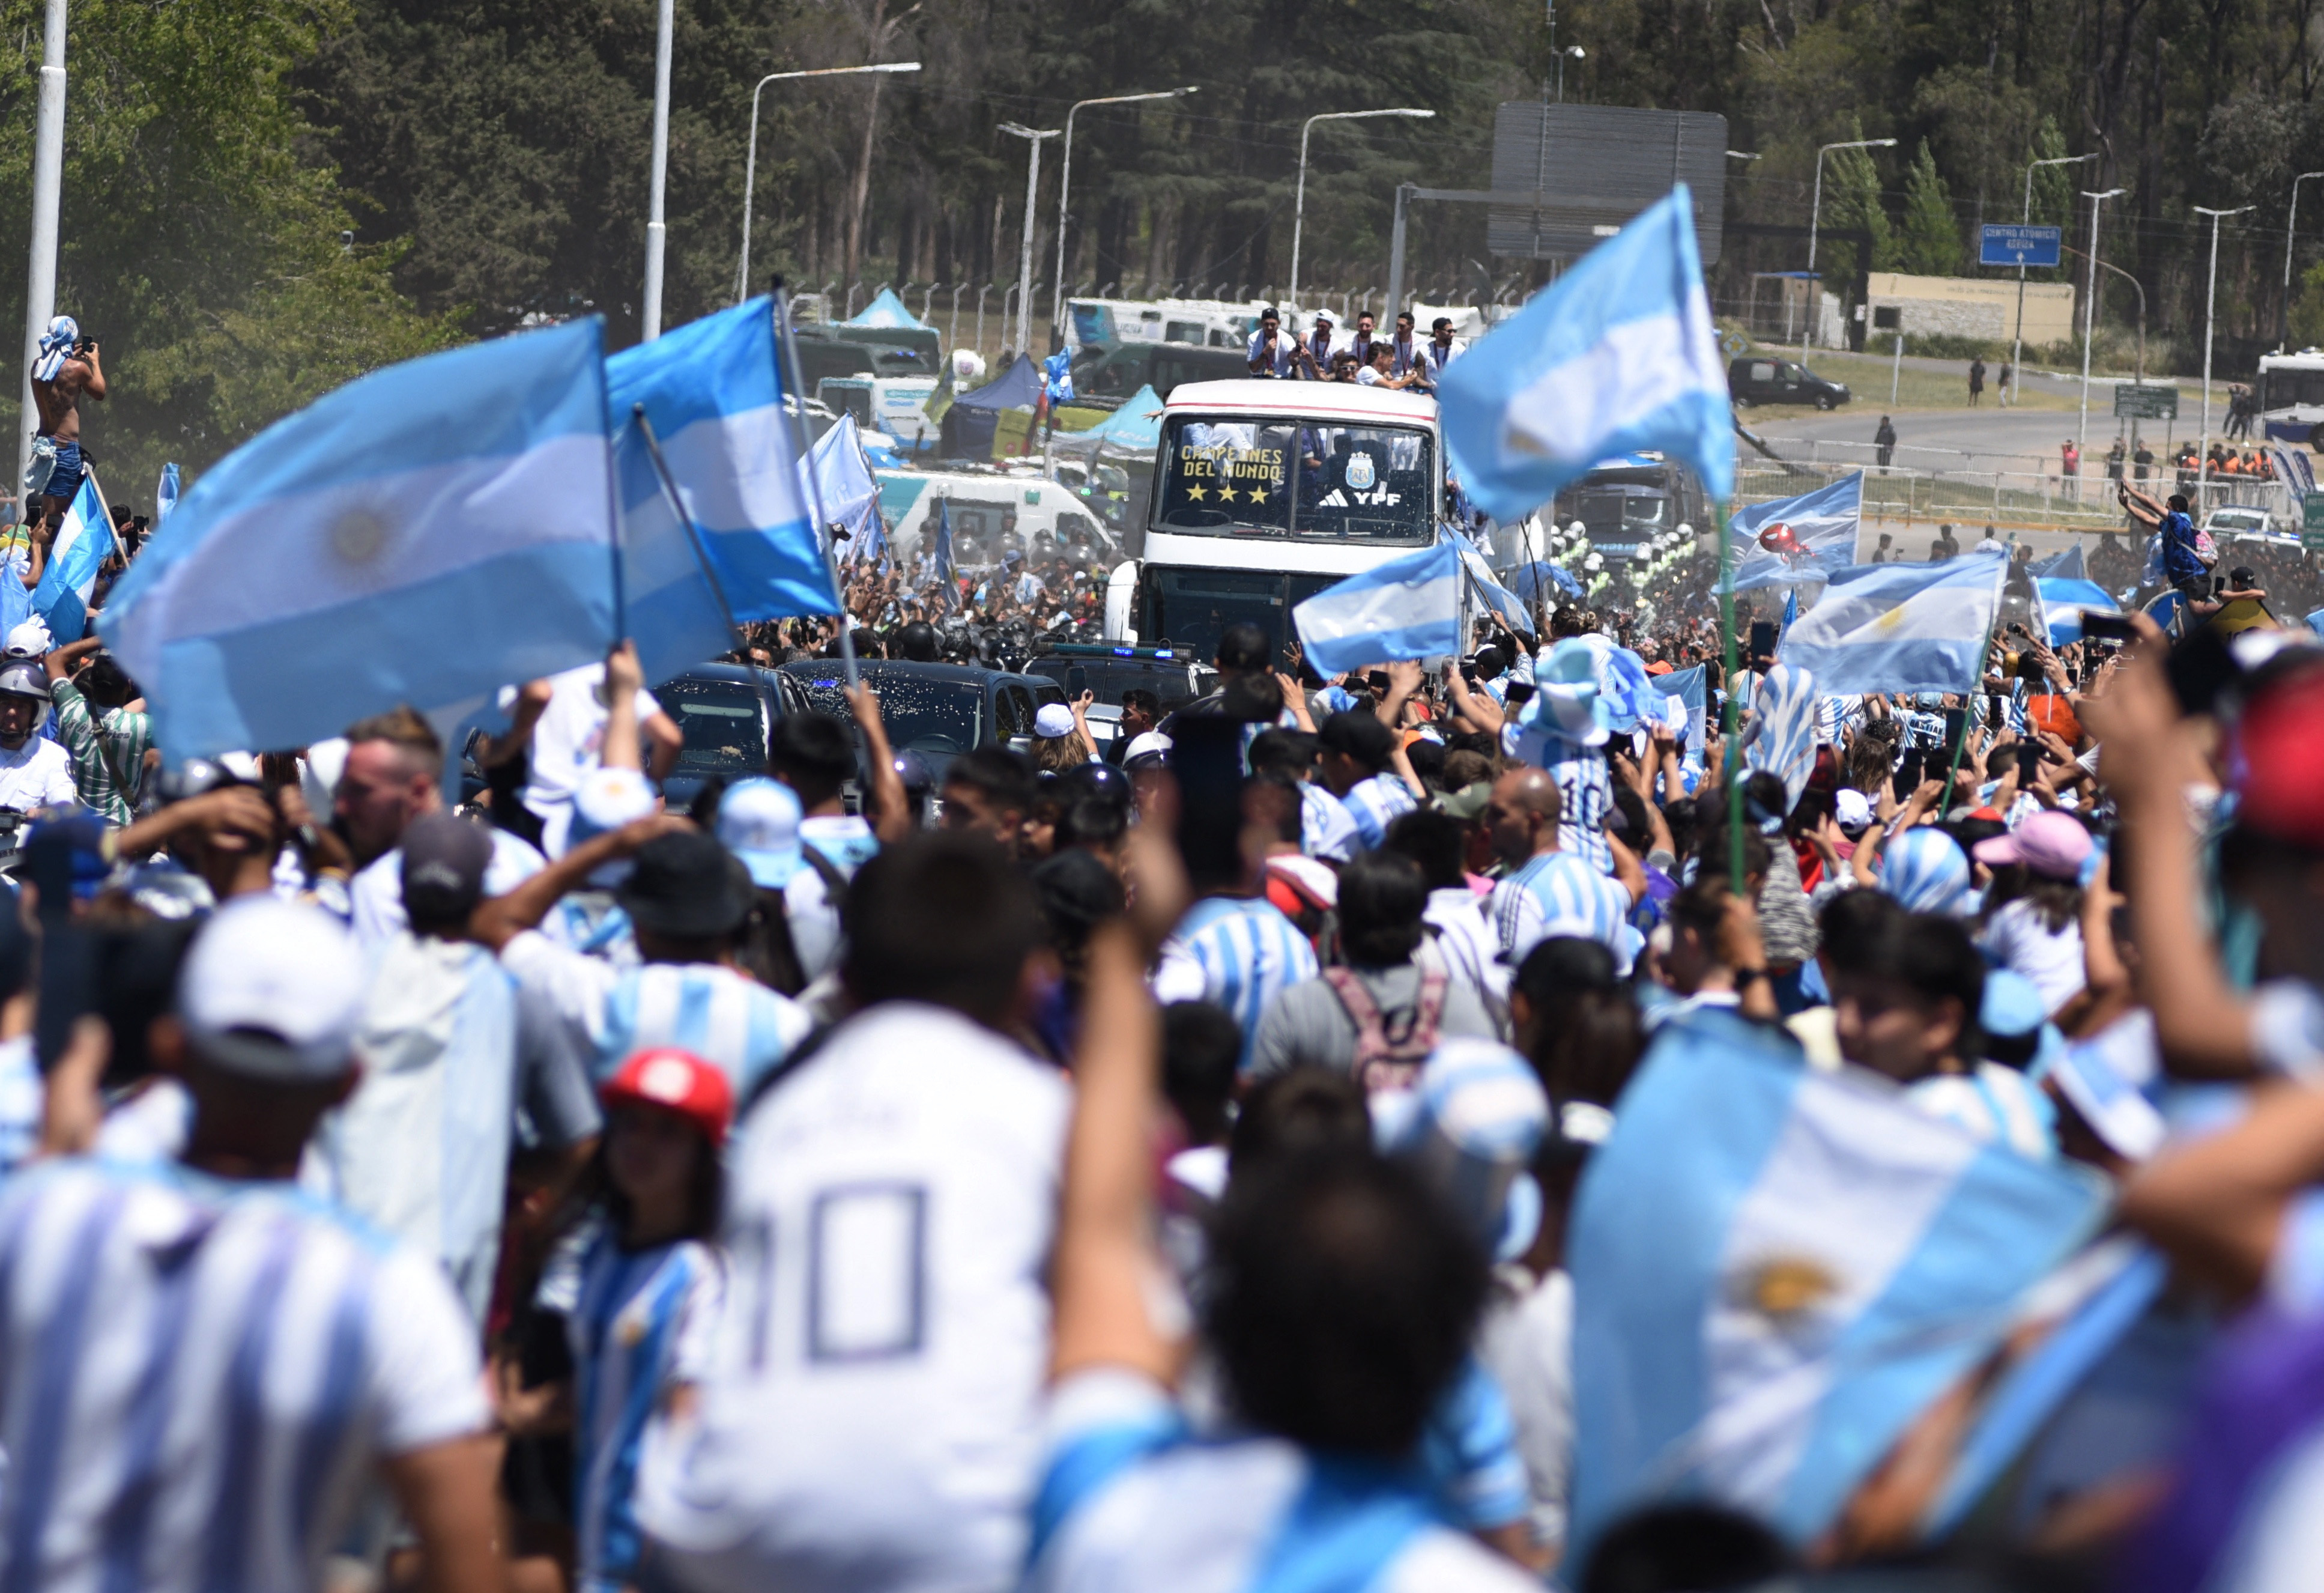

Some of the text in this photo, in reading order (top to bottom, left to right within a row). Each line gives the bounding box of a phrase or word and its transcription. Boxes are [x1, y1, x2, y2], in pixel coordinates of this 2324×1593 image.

[1181, 445, 1282, 464] CAMPEONES
[1184, 462, 1215, 476] DEL
[1223, 463, 1280, 479] MUNDO
[1354, 492, 1401, 506] YPF
[1910, 719, 1944, 736] BASTIAN
[1560, 777, 1602, 833] 10
[728, 1181, 928, 1376] 10
